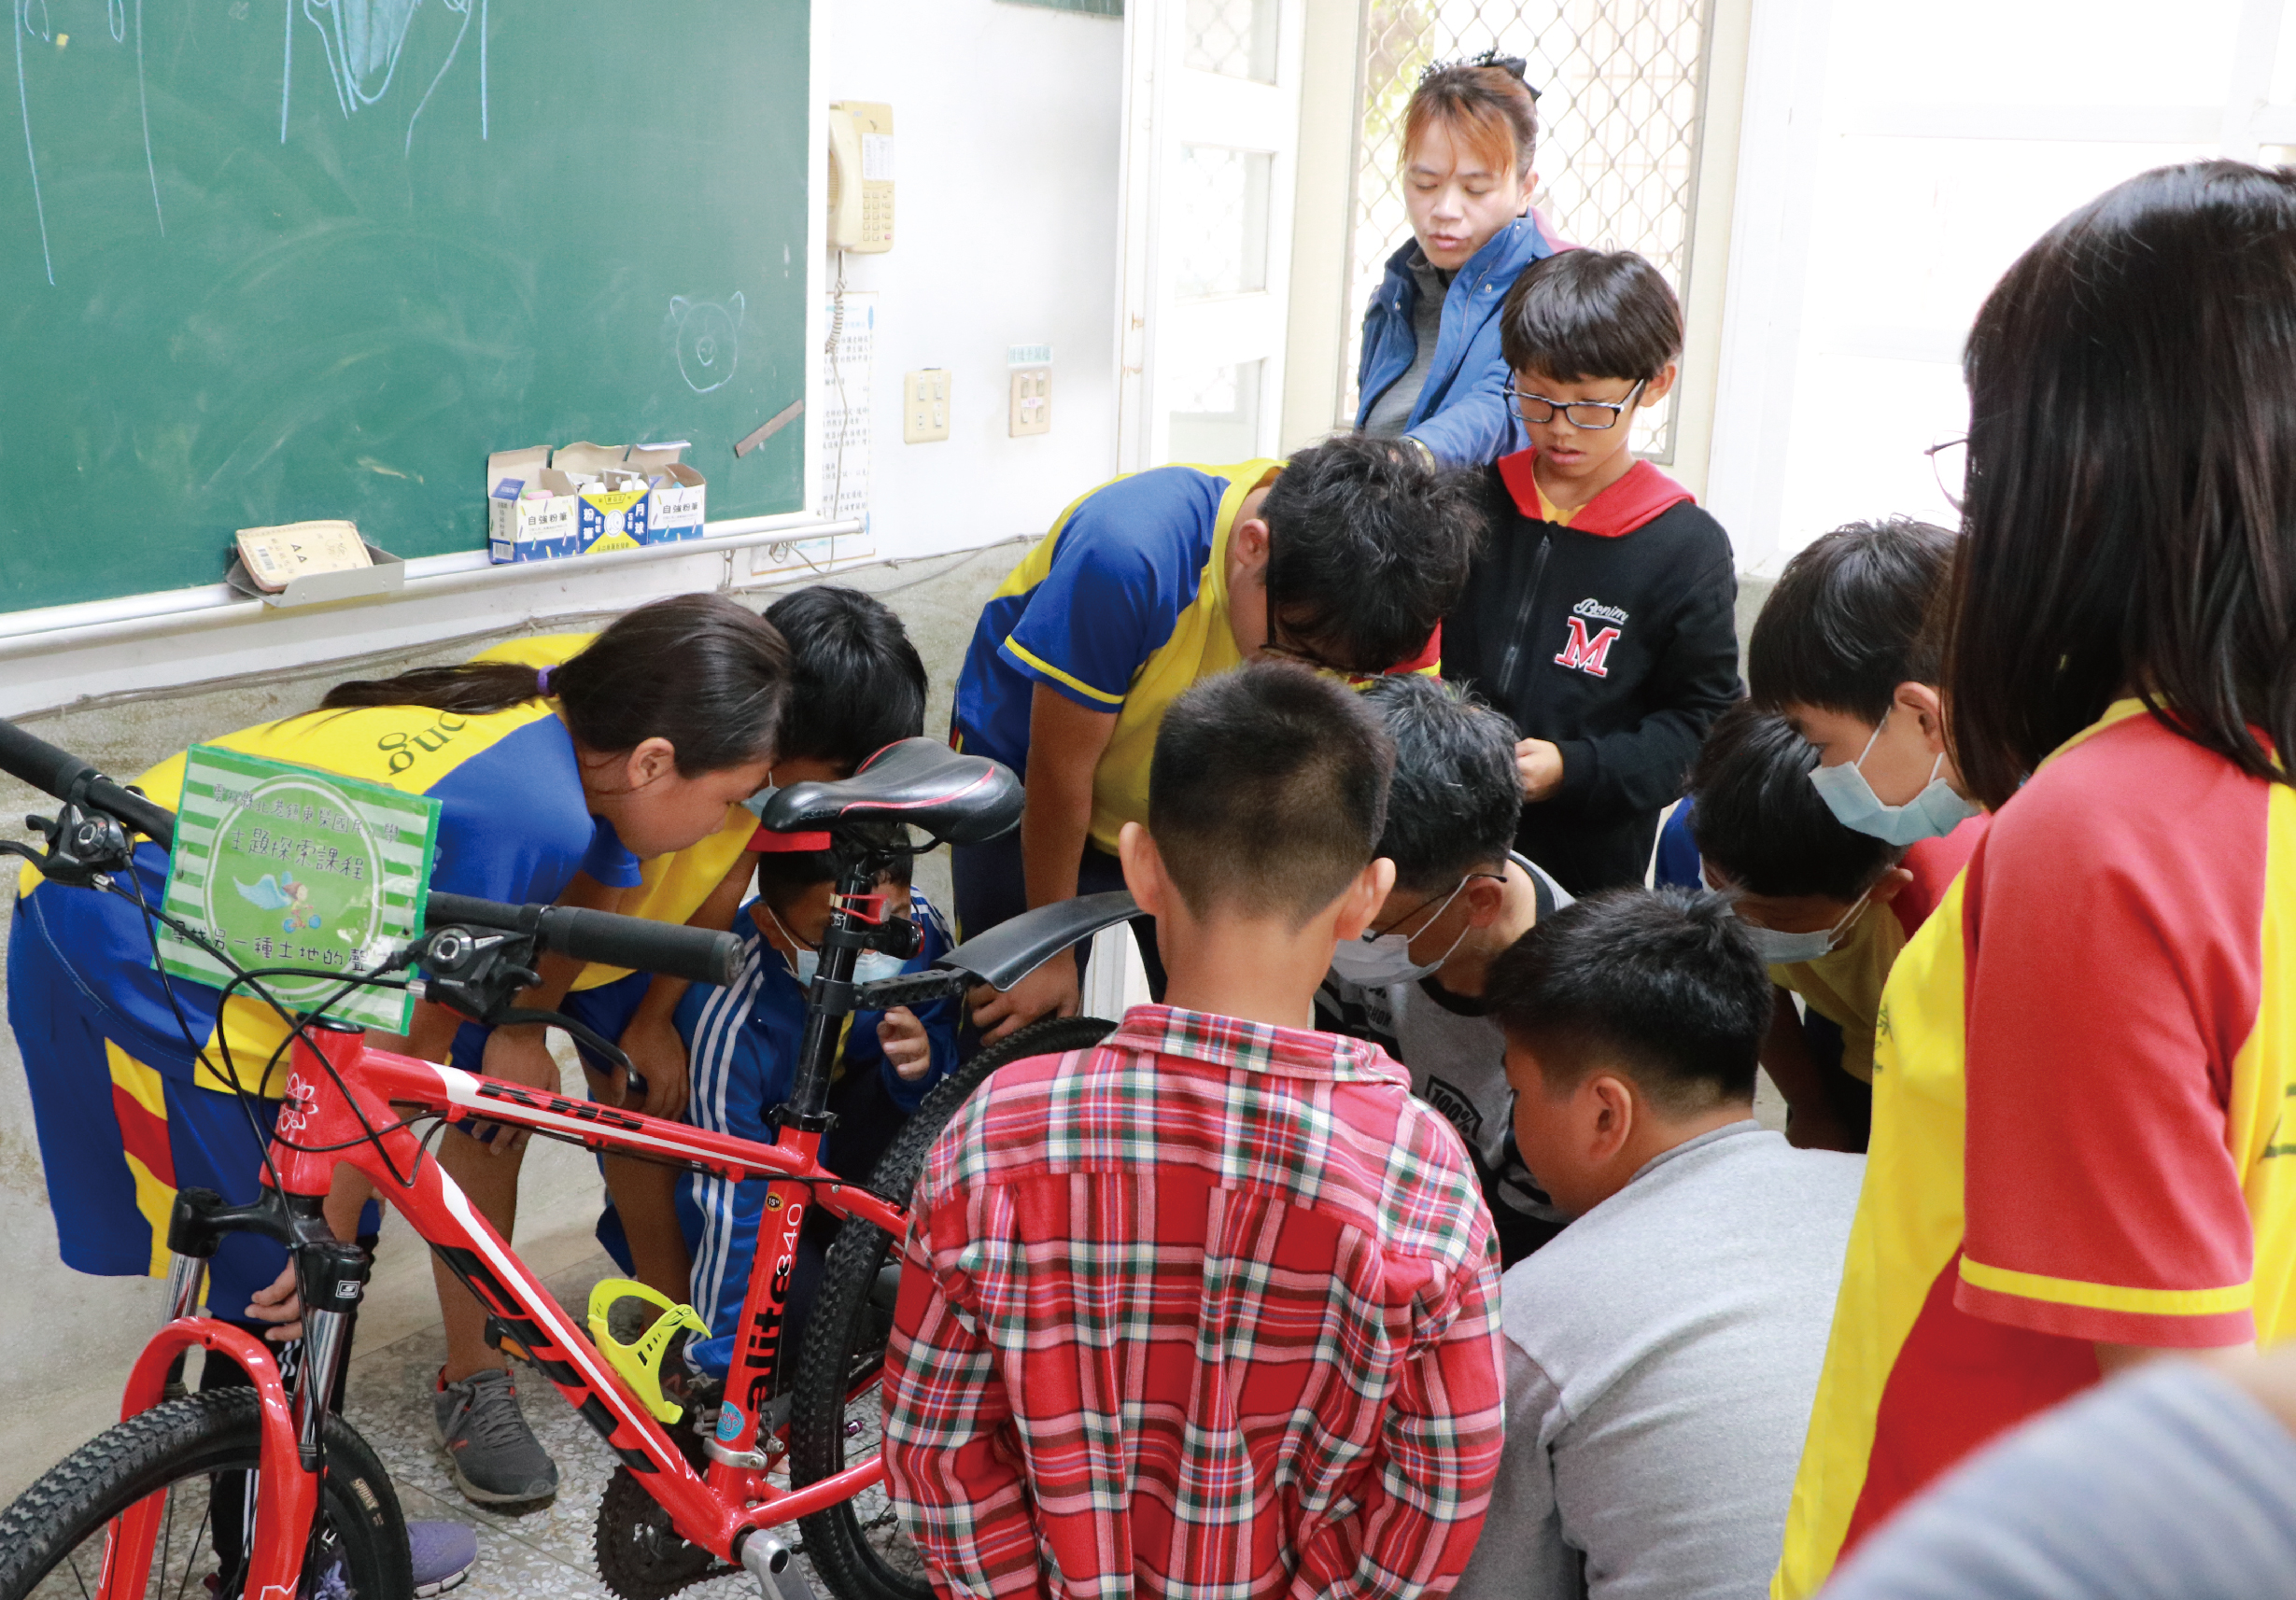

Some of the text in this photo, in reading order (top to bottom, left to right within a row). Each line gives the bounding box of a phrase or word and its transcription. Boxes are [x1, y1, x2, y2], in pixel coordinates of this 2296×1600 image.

[528, 512, 568, 526] 自強粉筆
[662, 501, 698, 514] 自強粉筆
[1554, 616, 1621, 678] M
[231, 828, 364, 880] 主題探索課程
[1430, 1088, 1475, 1133] 100%
[777, 1203, 802, 1276] 340
